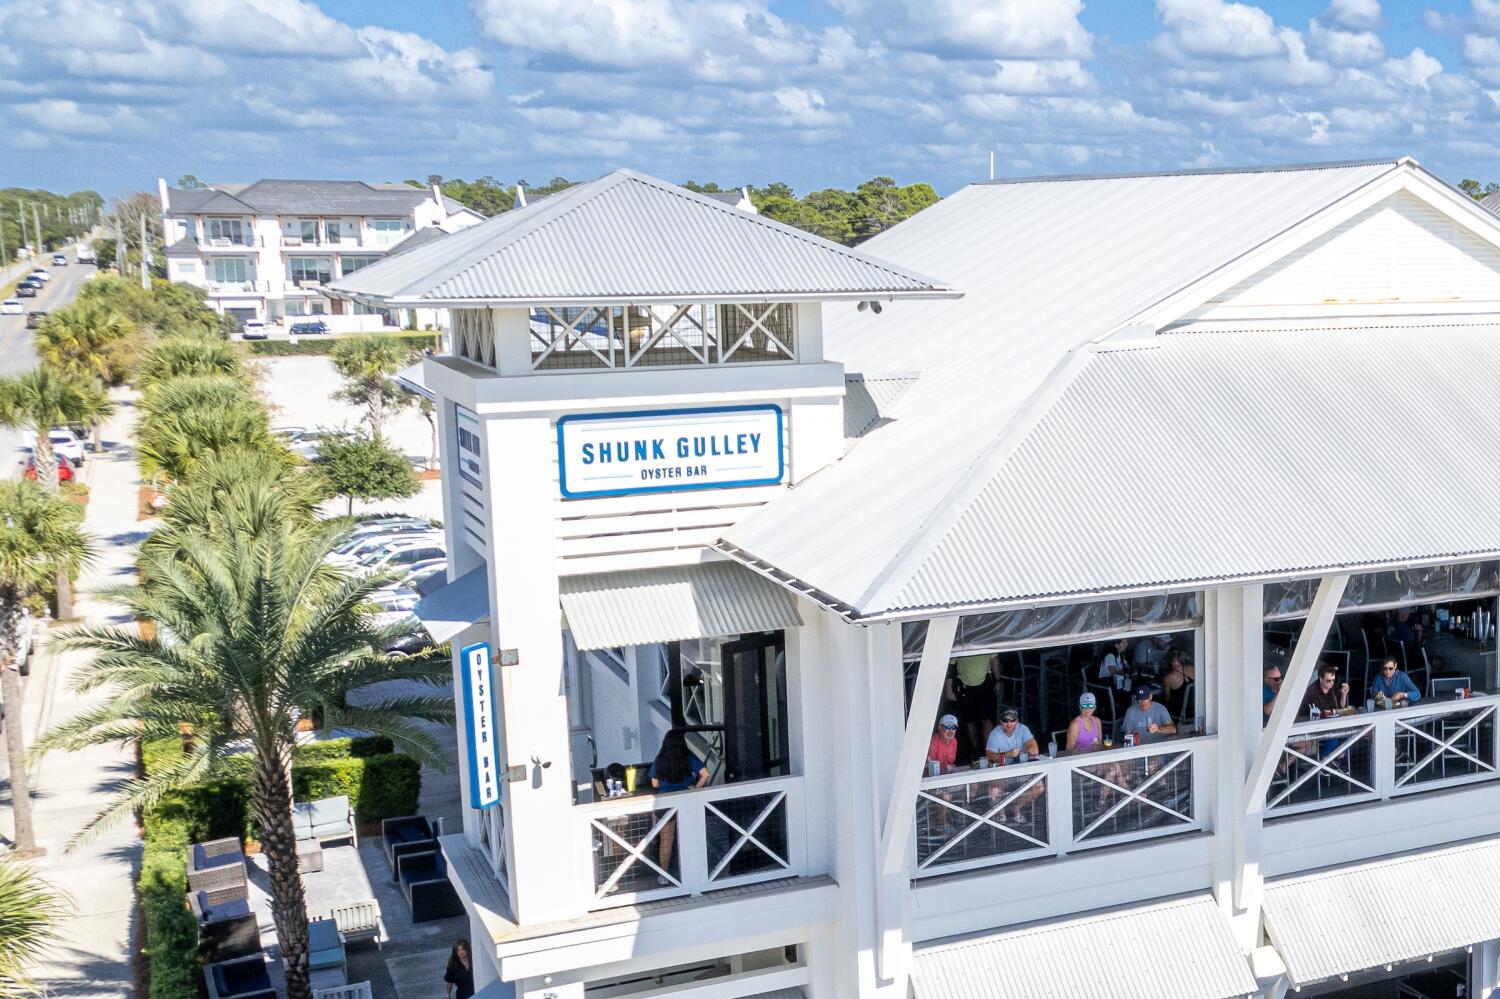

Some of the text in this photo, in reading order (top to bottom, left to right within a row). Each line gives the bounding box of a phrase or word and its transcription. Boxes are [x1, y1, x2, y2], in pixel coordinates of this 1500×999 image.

[582, 432, 761, 465] SHUNK GULLEY
[641, 465, 708, 481] OYSTER BAR
[476, 653, 492, 799] OYSTER BAR
